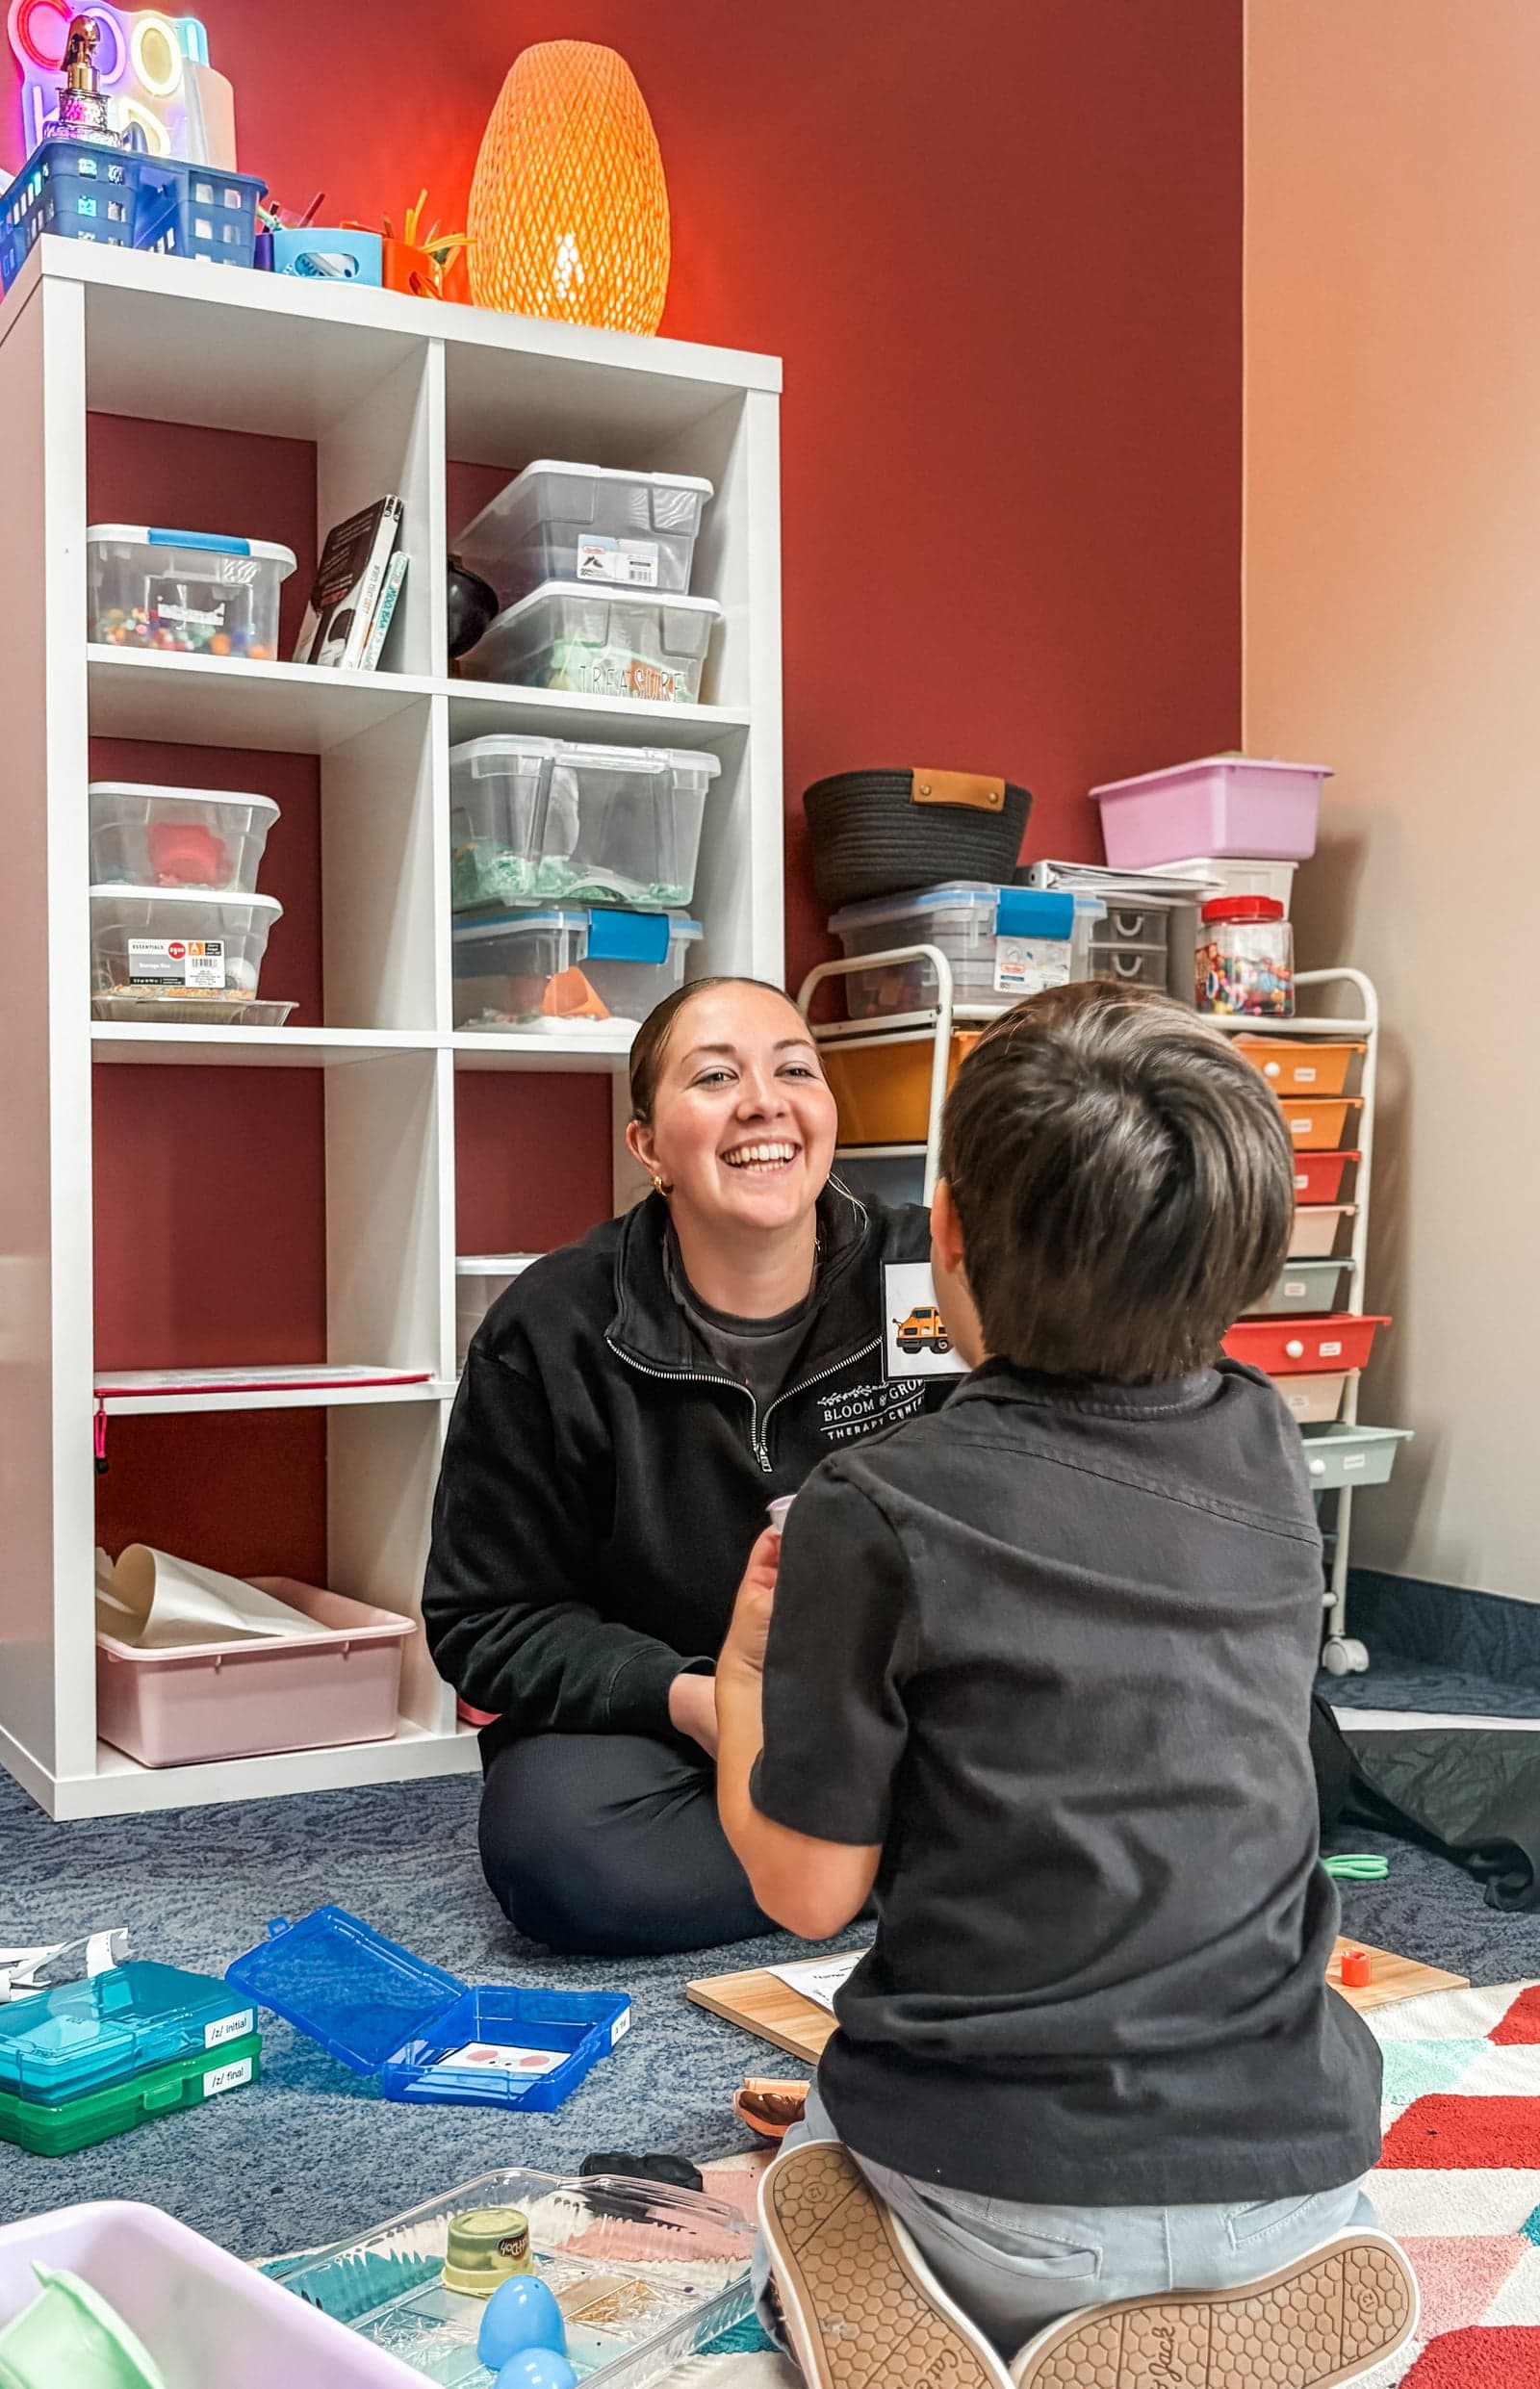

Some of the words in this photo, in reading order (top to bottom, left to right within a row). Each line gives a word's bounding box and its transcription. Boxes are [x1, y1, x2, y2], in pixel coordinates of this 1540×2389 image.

[17, 0, 201, 96] COO
[579, 665, 682, 703] TREASURE
[823, 1399, 875, 1423] BLOOM
[828, 1418, 885, 1441] THERAPY
[888, 1397, 925, 1421] CENT
[225, 2017, 247, 2034] initial
[226, 2066, 244, 2081] final
[925, 2349, 959, 2381] Cat
[1148, 2325, 1183, 2383] Jack
